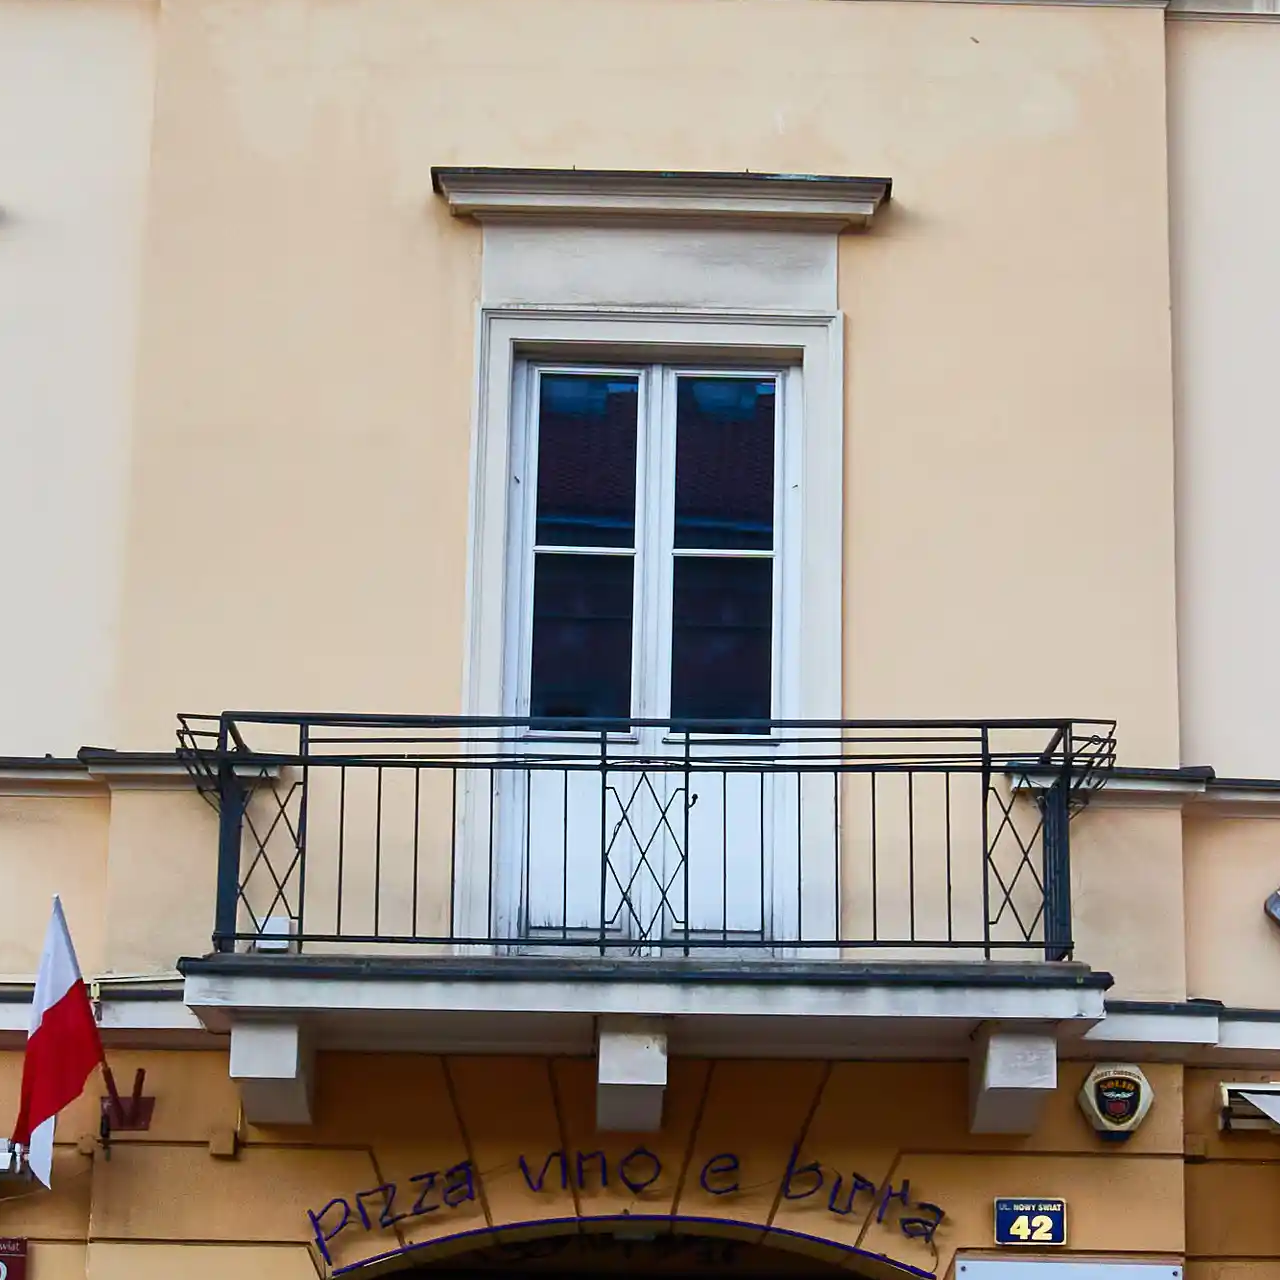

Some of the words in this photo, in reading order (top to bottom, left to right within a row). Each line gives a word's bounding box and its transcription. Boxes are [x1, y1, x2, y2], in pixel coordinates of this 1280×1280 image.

[307, 1160, 476, 1266] pizza
[519, 1147, 662, 1193] vino
[700, 1153, 739, 1195] e
[1009, 1215, 1054, 1240] 42
